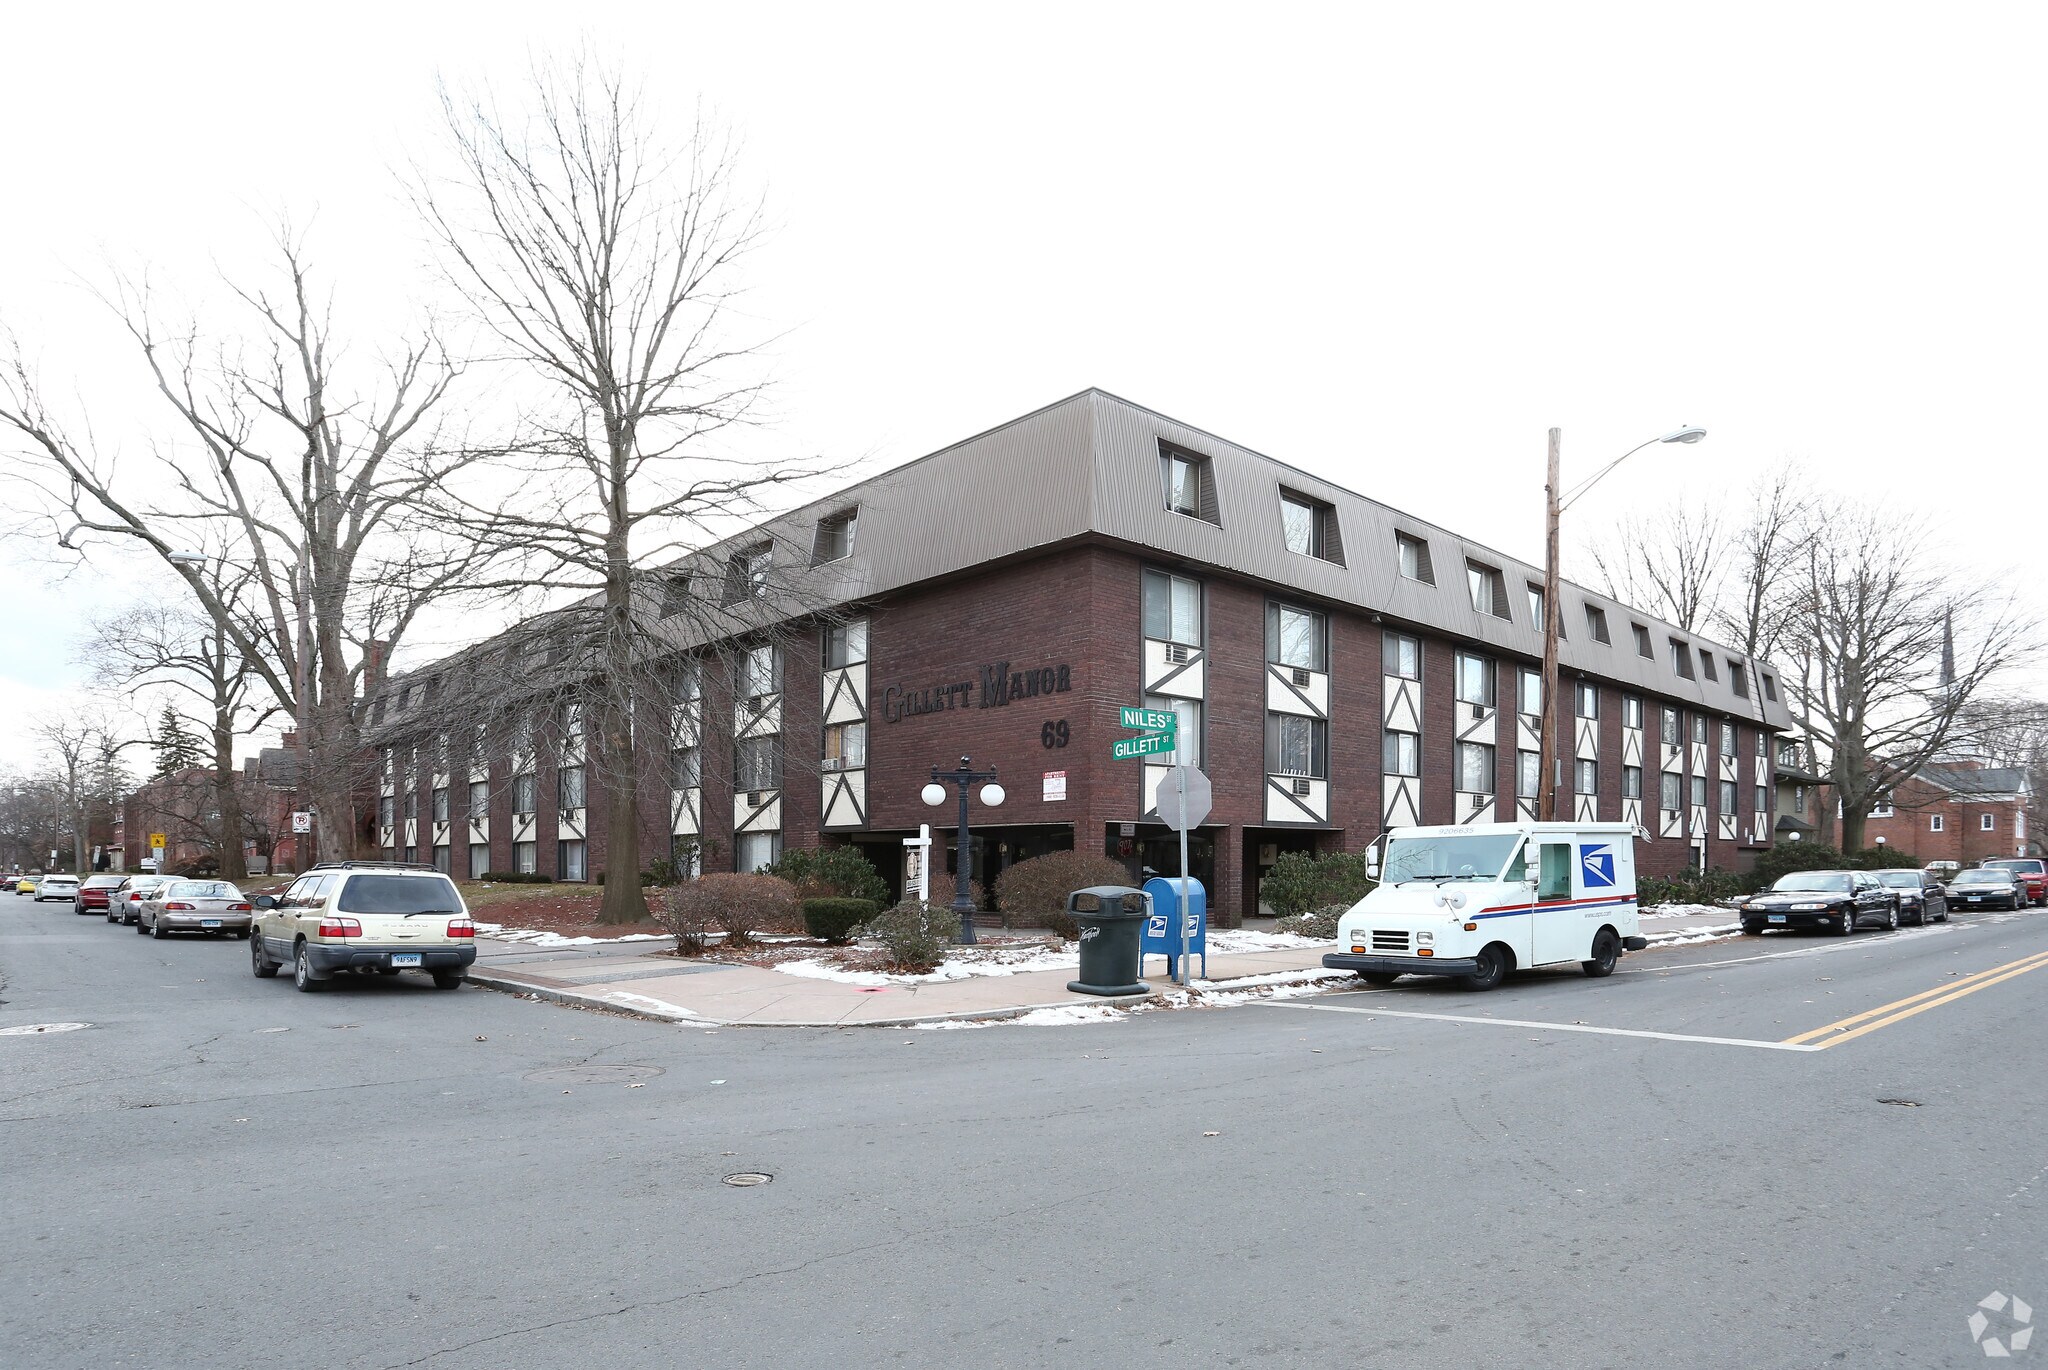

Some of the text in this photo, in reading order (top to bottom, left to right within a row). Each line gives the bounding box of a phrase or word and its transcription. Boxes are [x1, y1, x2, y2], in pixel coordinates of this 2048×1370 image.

[1124, 710, 1172, 728] NILES ST
[1041, 719, 1070, 749] 69
[1115, 735, 1170, 757] GILLETT ST
